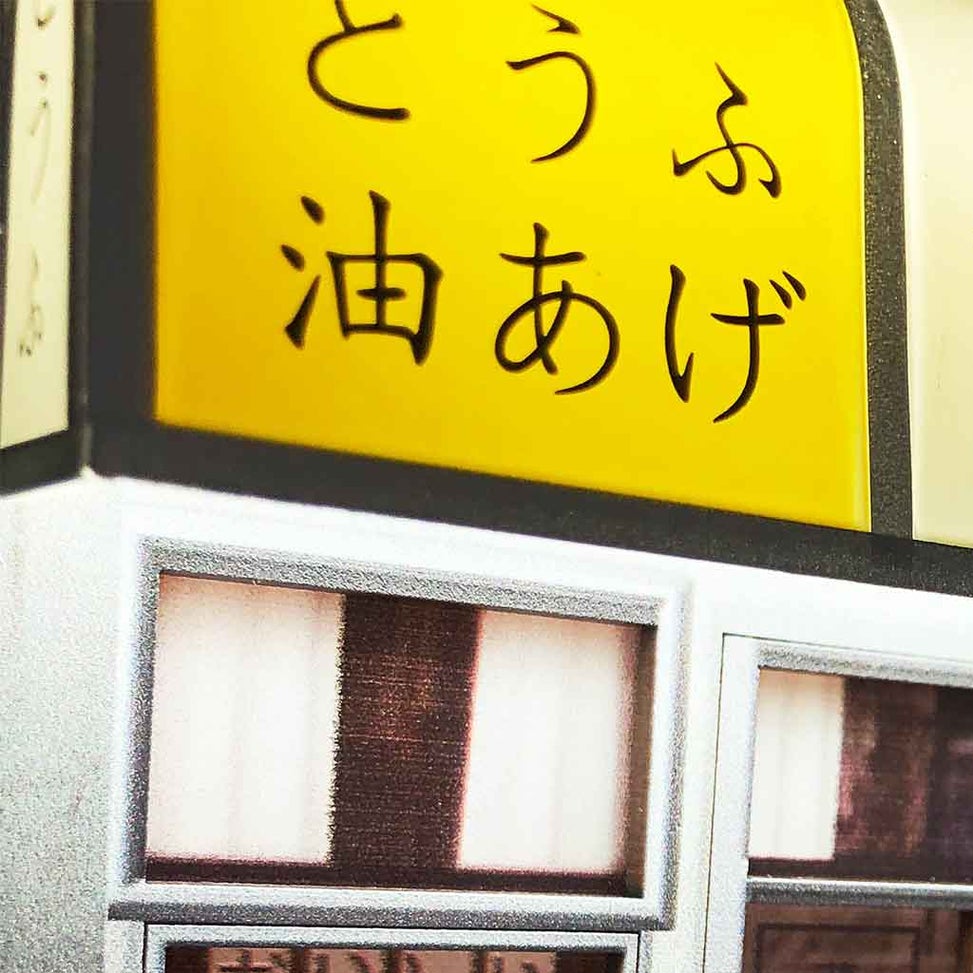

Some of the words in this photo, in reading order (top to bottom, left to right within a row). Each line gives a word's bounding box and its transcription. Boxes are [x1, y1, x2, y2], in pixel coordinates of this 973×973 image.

[307, 0, 783, 199] とうふ
[280, 190, 807, 424] 油あげ
